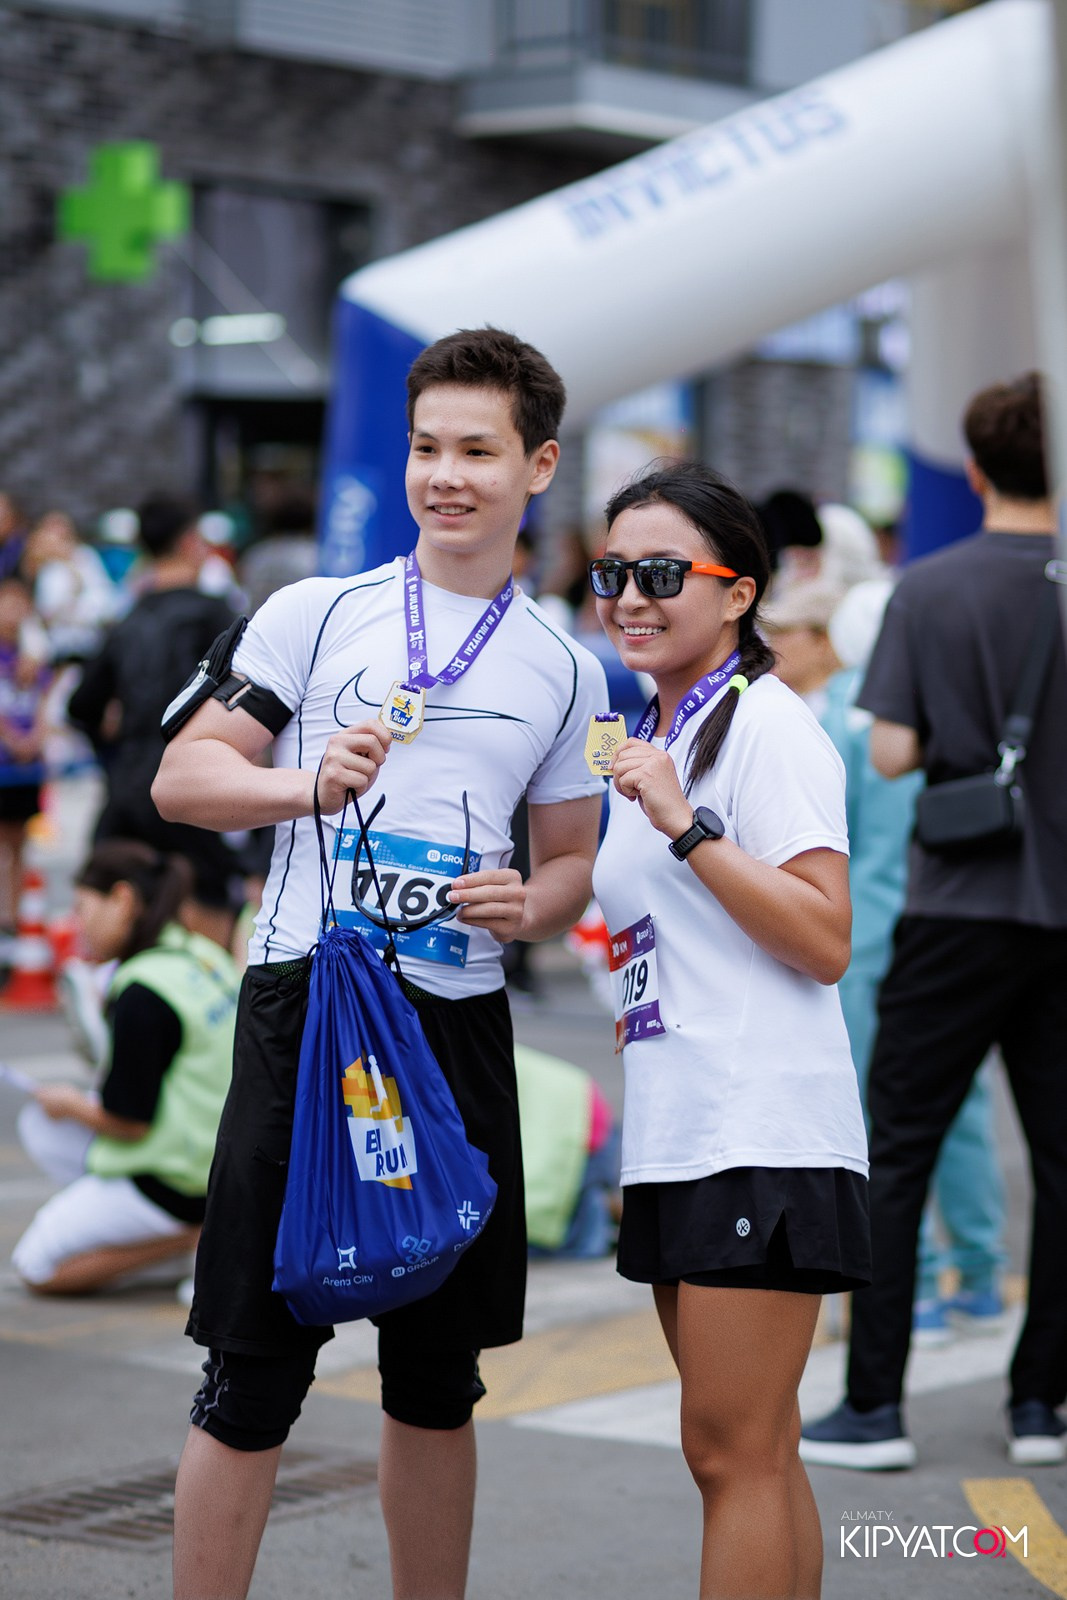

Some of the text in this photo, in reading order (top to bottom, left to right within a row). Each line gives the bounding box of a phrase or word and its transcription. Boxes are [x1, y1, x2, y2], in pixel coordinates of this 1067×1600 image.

[707, 671, 726, 686] City
[683, 699, 696, 712] BI
[406, 1255, 440, 1273] GROUP
[322, 1274, 374, 1287] Arena City
